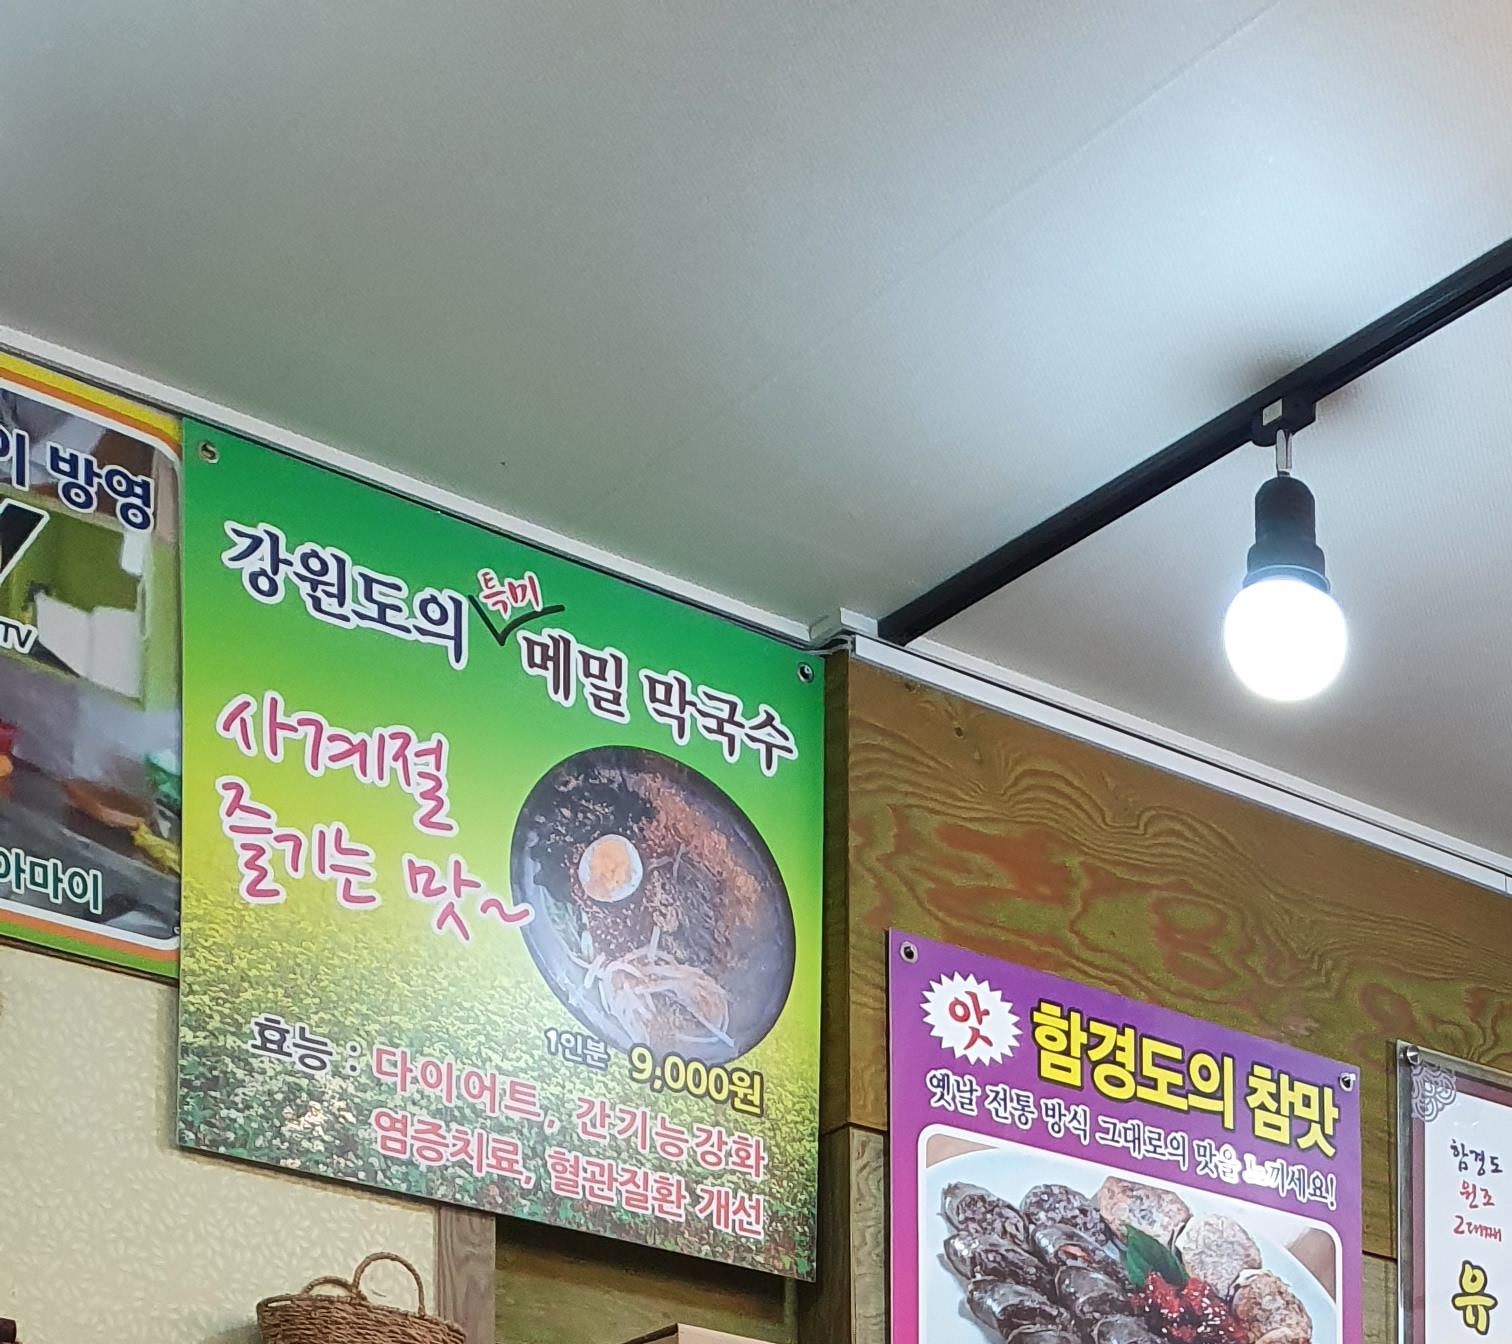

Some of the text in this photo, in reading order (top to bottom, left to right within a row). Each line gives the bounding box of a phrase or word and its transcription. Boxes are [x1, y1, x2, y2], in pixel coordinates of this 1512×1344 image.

[47, 446, 153, 530] 방영
[225, 523, 468, 667] 강원도의
[479, 570, 541, 617] 특미
[520, 631, 796, 773] 메밀 막국수
[221, 695, 455, 833] 사계절
[221, 781, 378, 904] 즐기는
[249, 1016, 767, 1179] 효능 다이어트, 간기능강화
[546, 1028, 766, 1117] 1인분 9,000원
[927, 1071, 981, 1113] 옛날
[986, 1085, 1037, 1126] 전통
[1043, 1101, 1091, 1146] 방식
[1097, 1118, 1188, 1170] 그대로의
[1195, 1141, 1241, 1182] 맛을
[1032, 1000, 1340, 1158] 함경도의 참맛
[371, 1107, 767, 1240] 염증치료, 혈관질환 개선
[1451, 1139, 1503, 1176] 함경도
[1459, 1180, 1496, 1209] 원조
